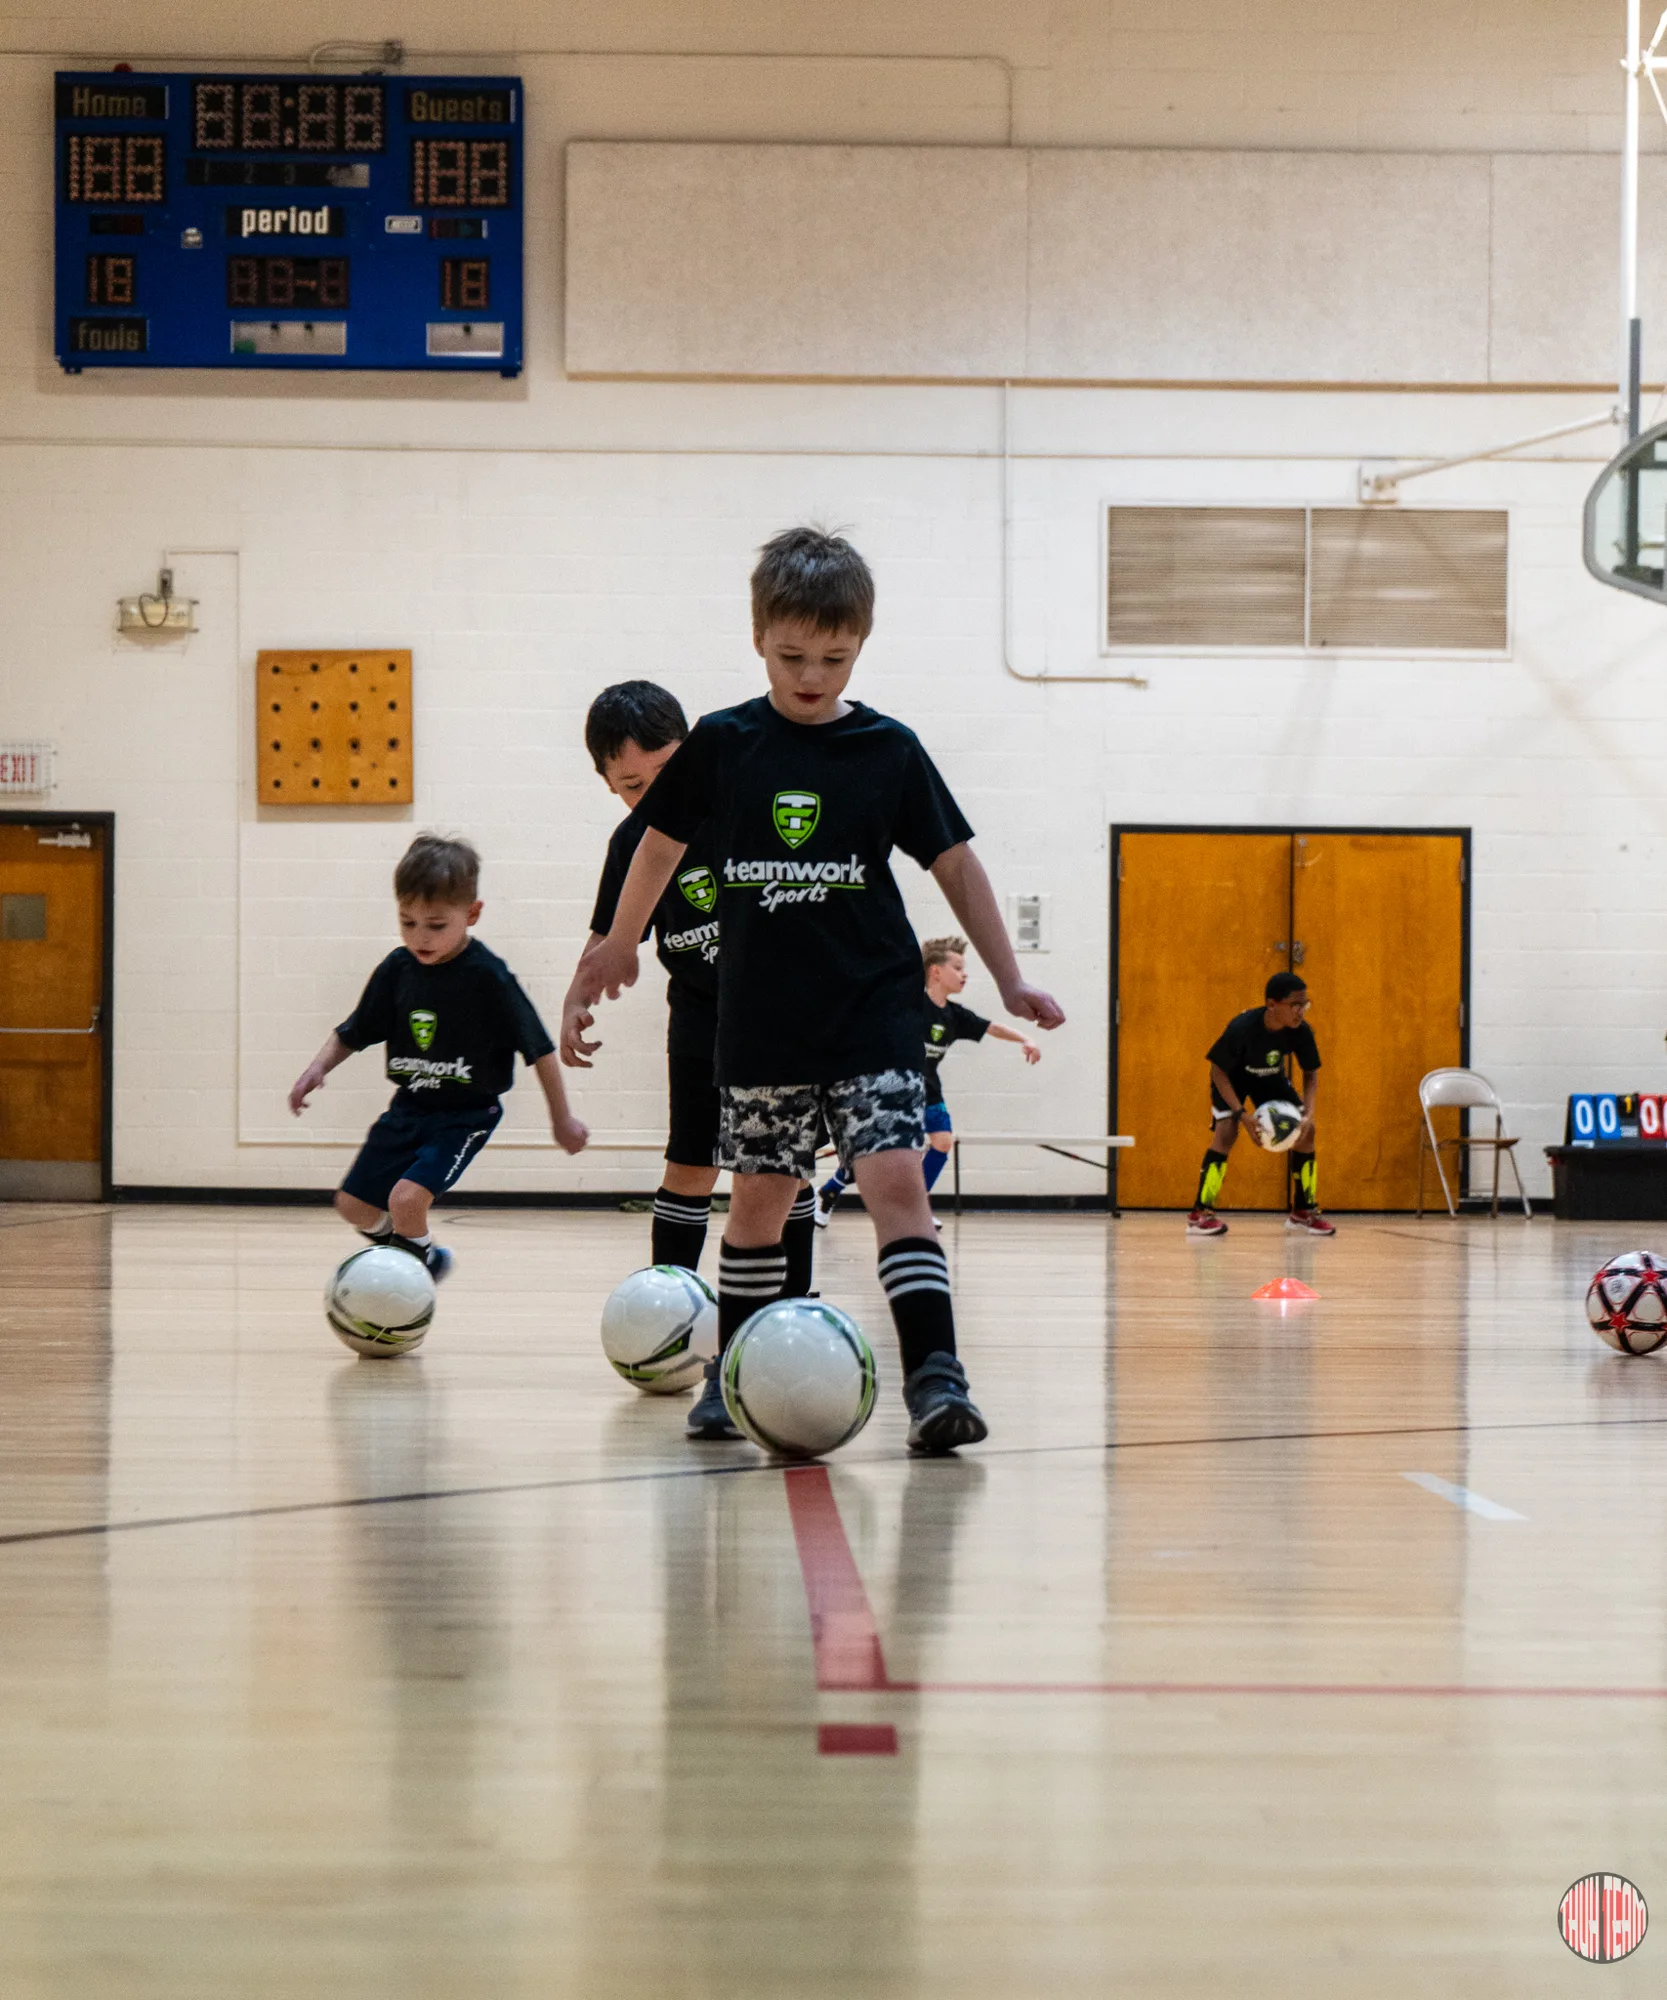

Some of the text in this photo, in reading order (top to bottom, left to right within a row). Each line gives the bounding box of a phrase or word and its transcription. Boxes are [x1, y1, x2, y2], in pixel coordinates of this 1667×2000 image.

[72, 85, 148, 118] Home
[410, 90, 504, 122] Guests
[241, 205, 330, 238] period
[0, 754, 37, 783] EXIT
[723, 854, 866, 884] teamwork
[758, 880, 828, 913] Sports
[663, 920, 719, 950] team
[1574, 1098, 1618, 1134] 00
